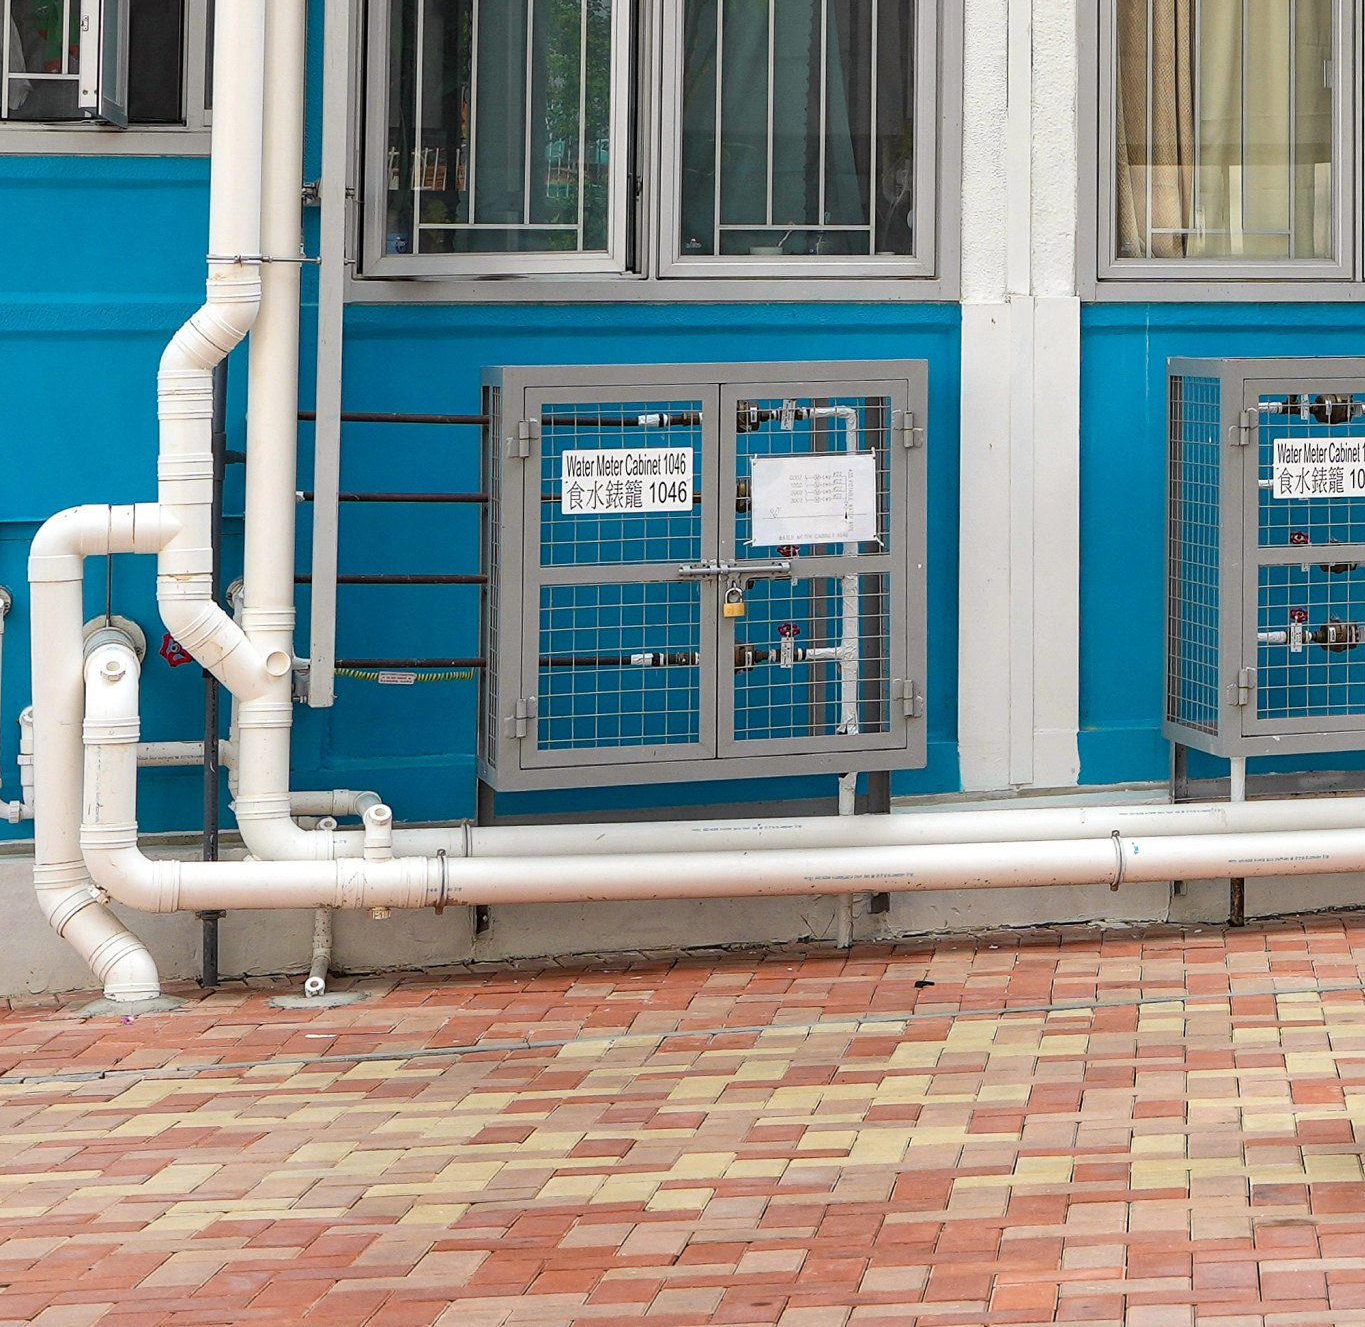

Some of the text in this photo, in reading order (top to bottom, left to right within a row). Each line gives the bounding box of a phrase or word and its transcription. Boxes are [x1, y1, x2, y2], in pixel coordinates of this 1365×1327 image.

[566, 453, 687, 477] Water Meter Cabinet 1046
[1277, 443, 1302, 464] Water
[1303, 443, 1327, 464] Meter
[1328, 442, 1360, 463] Cabinet
[566, 479, 688, 510] 食水錶籠 1046
